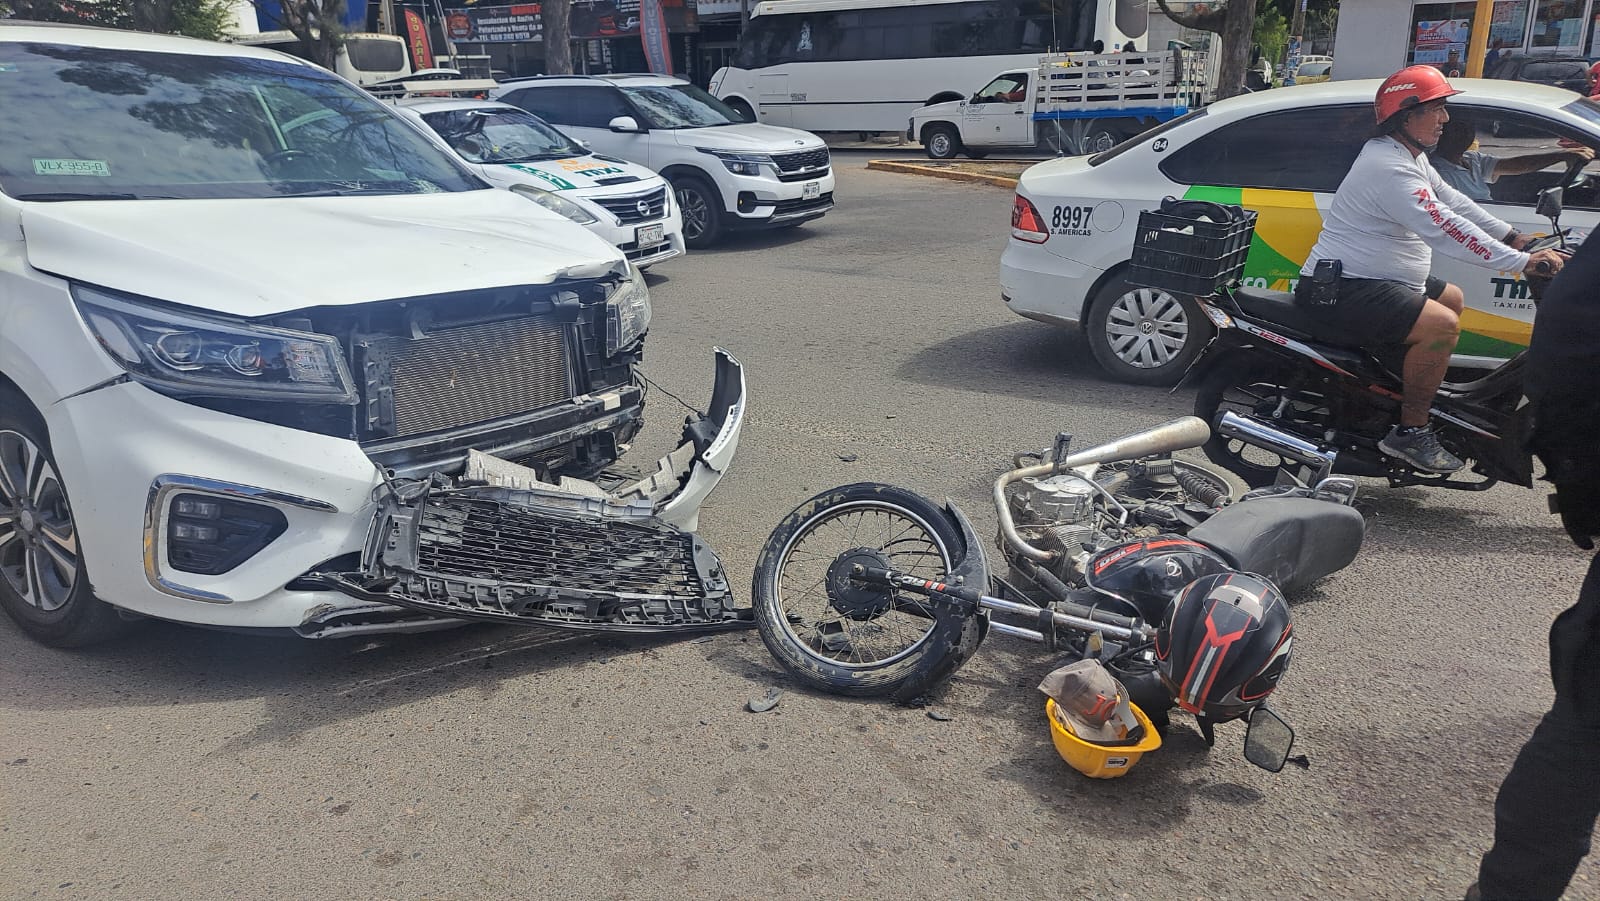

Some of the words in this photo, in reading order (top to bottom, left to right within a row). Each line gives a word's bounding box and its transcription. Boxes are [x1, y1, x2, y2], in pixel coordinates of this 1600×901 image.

[1153, 140, 1168, 150] 84
[1052, 205, 1094, 229] 8997
[1050, 228, 1057, 236] S.
[1058, 228, 1092, 237] AMERICAS
[1440, 217, 1470, 244] Island
[1465, 235, 1492, 261] Tours
[1493, 301, 1534, 310] TAXIME
